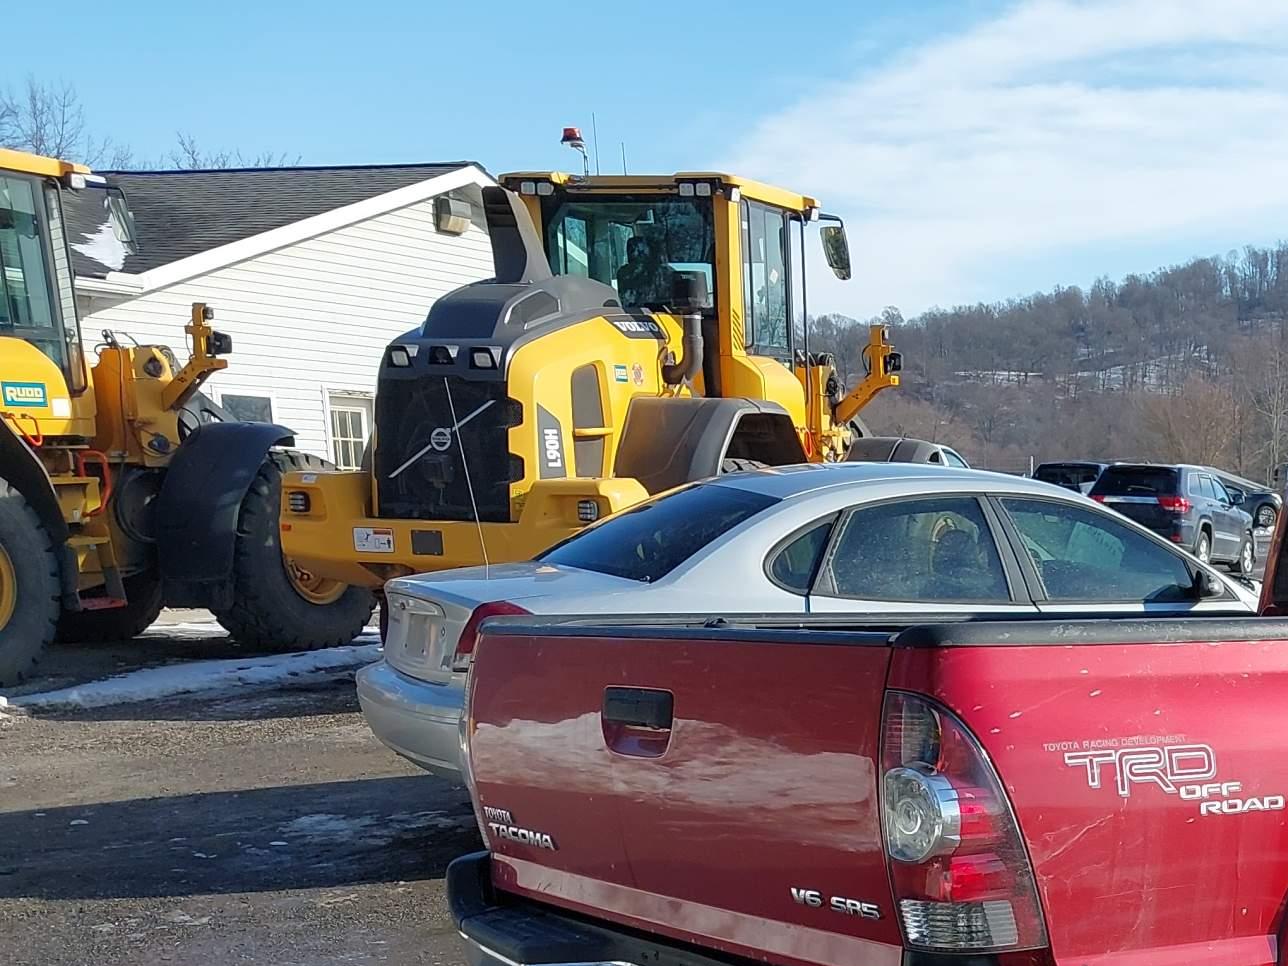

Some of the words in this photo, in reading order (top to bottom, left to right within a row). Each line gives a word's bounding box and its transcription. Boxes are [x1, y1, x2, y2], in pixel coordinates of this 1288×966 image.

[613, 321, 659, 332] VOLVO
[5, 386, 44, 402] RUDD
[544, 428, 562, 468] L90H
[1043, 740, 1079, 752] TOYOTA
[1082, 737, 1119, 749] RACING
[1121, 735, 1186, 746] DEVELOPMENT
[1064, 743, 1217, 798] TRD
[1179, 781, 1243, 799] OFF
[483, 806, 512, 824] TOYOTA
[1199, 795, 1285, 816] ROAD
[488, 822, 555, 851] TACOMA
[791, 887, 821, 907] V6
[830, 896, 880, 920] SR5
